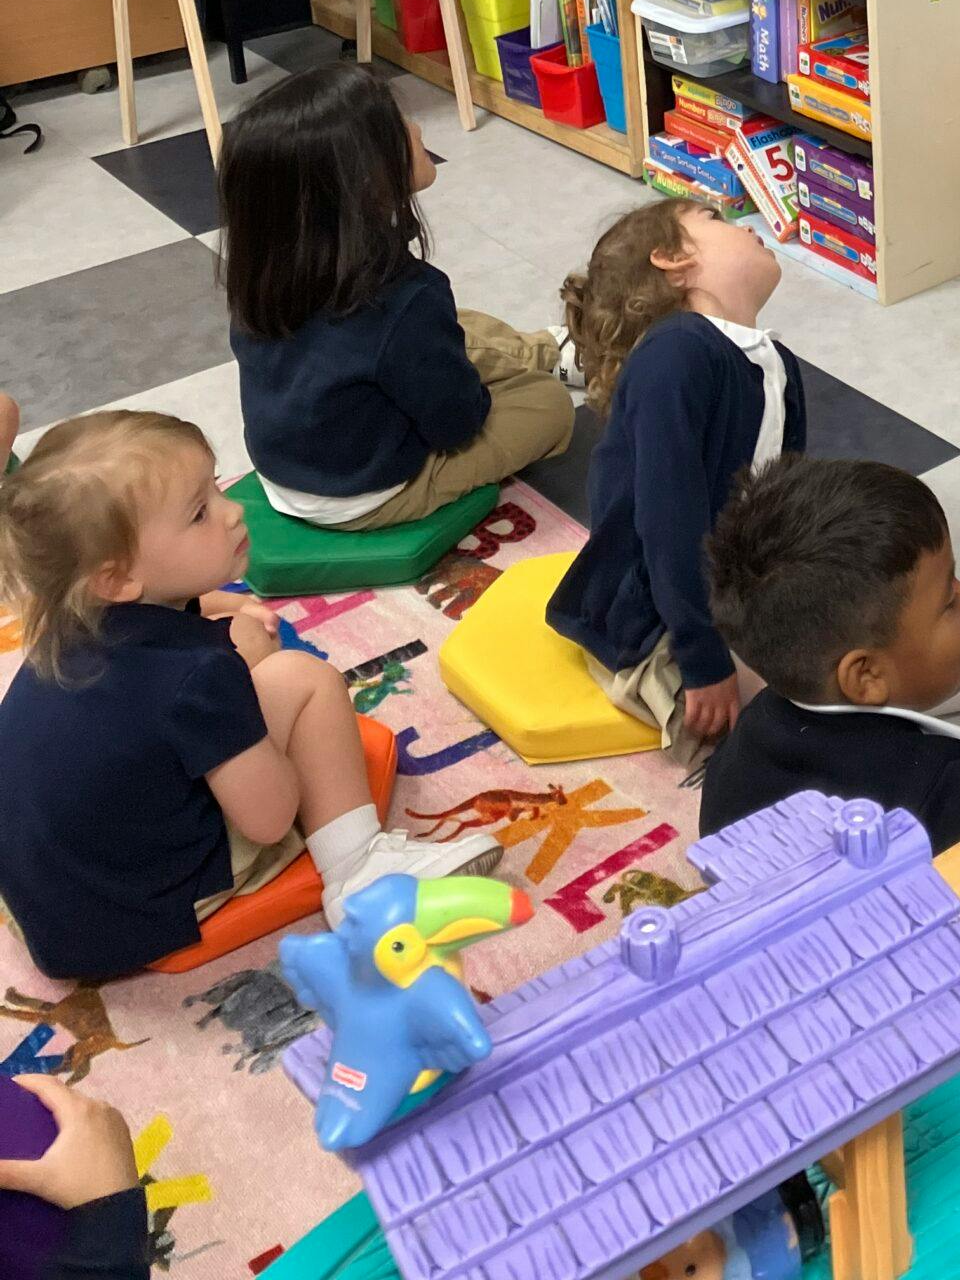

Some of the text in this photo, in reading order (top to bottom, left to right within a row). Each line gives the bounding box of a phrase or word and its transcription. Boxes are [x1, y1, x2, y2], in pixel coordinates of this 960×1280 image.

[759, 27, 770, 72] Math
[678, 97, 706, 117] Numbers
[765, 145, 794, 181] 5
[656, 170, 689, 198] Numbers
